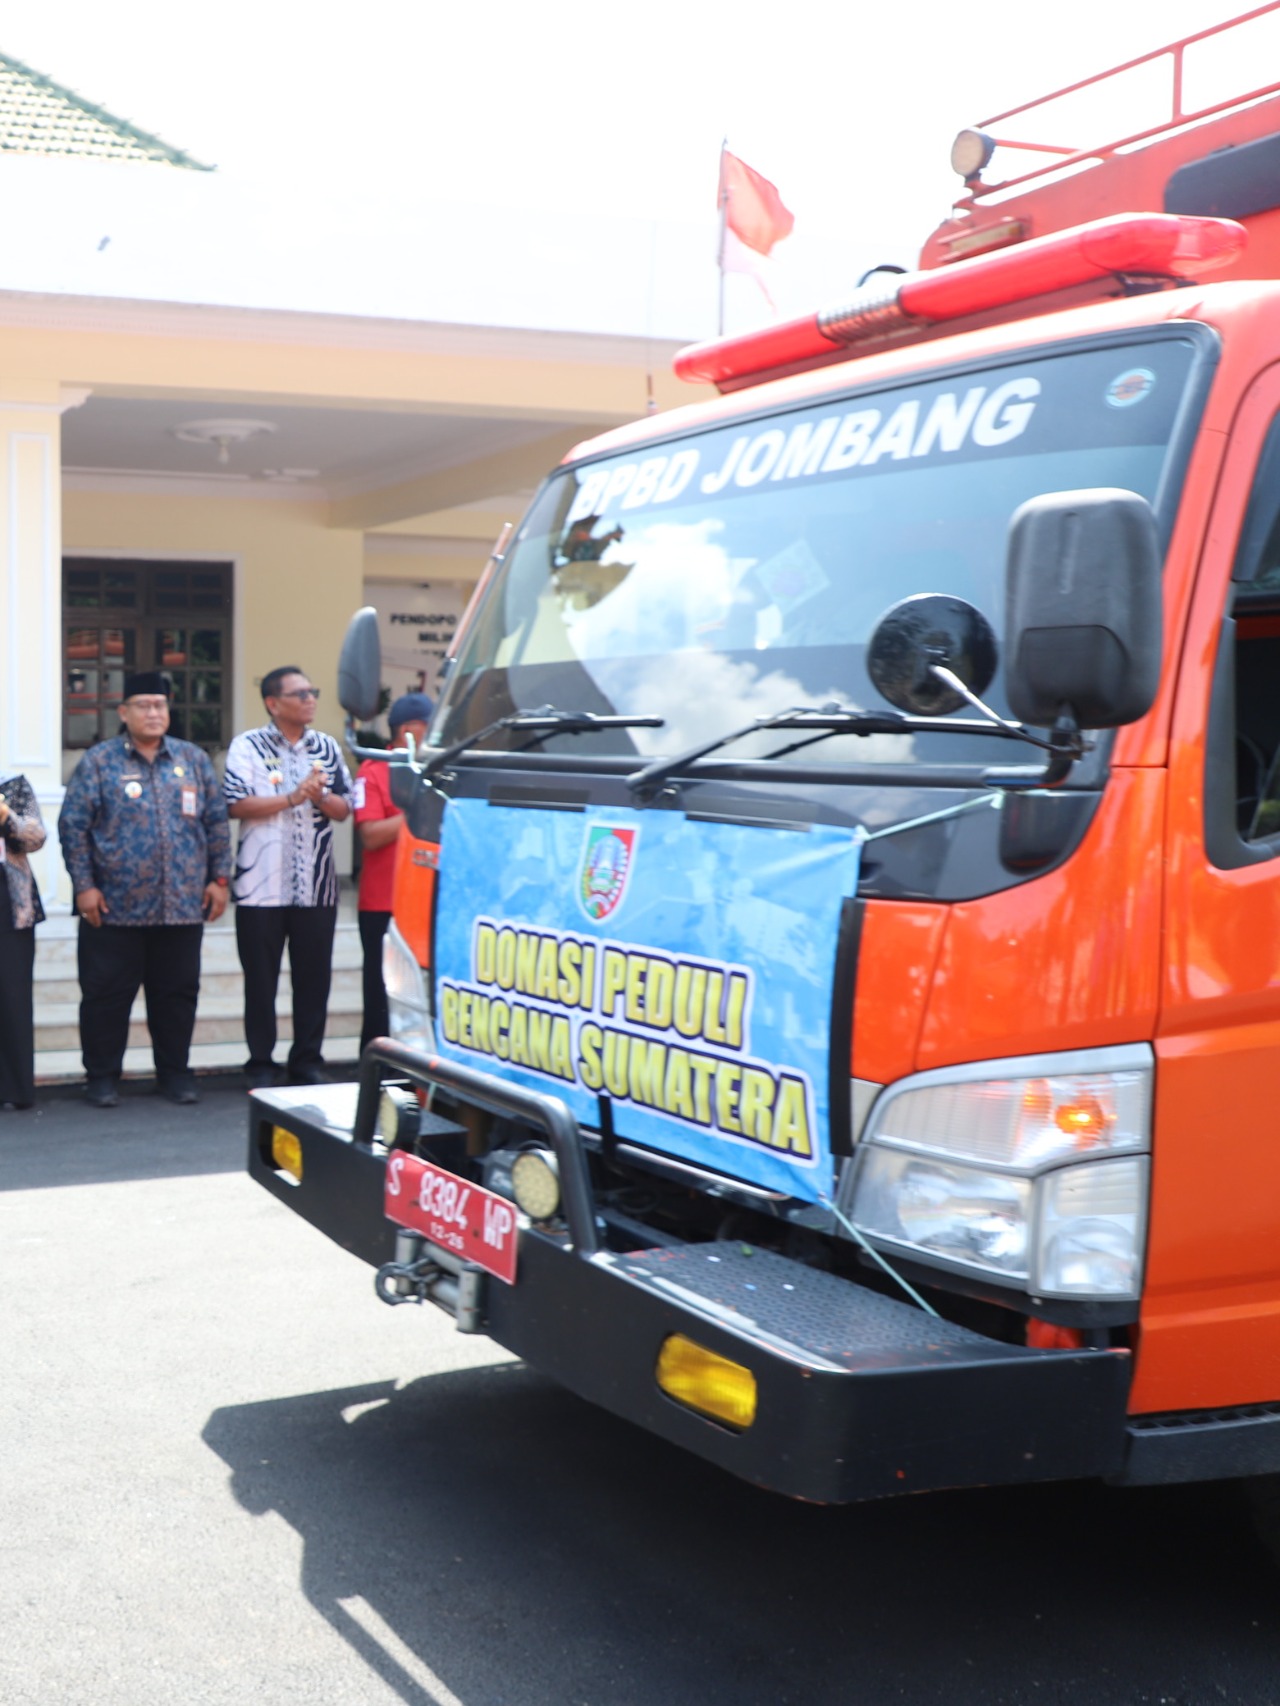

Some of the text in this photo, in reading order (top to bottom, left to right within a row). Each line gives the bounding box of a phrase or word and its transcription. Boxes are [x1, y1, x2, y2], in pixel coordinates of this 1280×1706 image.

[566, 377, 1041, 522] BPBD JOMBANG
[390, 613, 458, 626] PENDOPO
[476, 922, 748, 1051] DONASI PEDULI
[441, 983, 813, 1160] BENCANA SUMATERA
[387, 1157, 512, 1251] S 8384 WP
